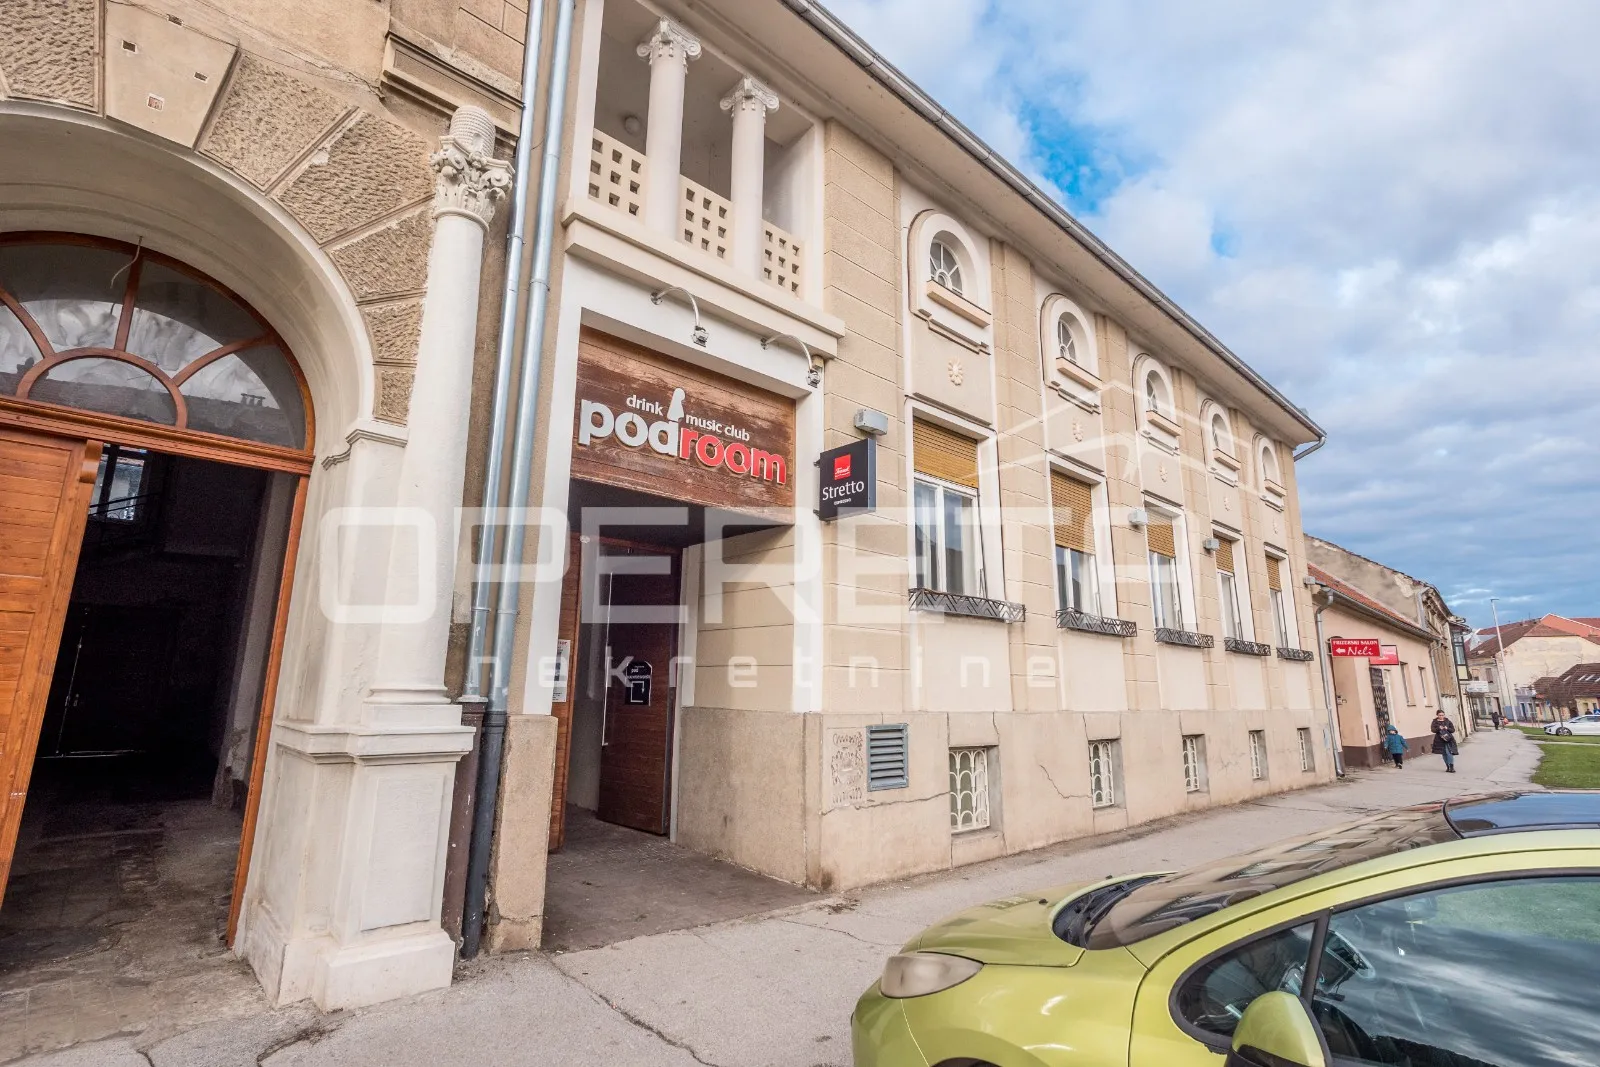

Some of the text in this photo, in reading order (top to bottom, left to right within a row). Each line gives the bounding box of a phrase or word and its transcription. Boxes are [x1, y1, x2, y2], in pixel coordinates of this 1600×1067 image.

[626, 394, 750, 442] drink music club
[577, 388, 787, 484] podroom
[822, 480, 865, 501] Stretto
[1347, 646, 1374, 656] Neli
